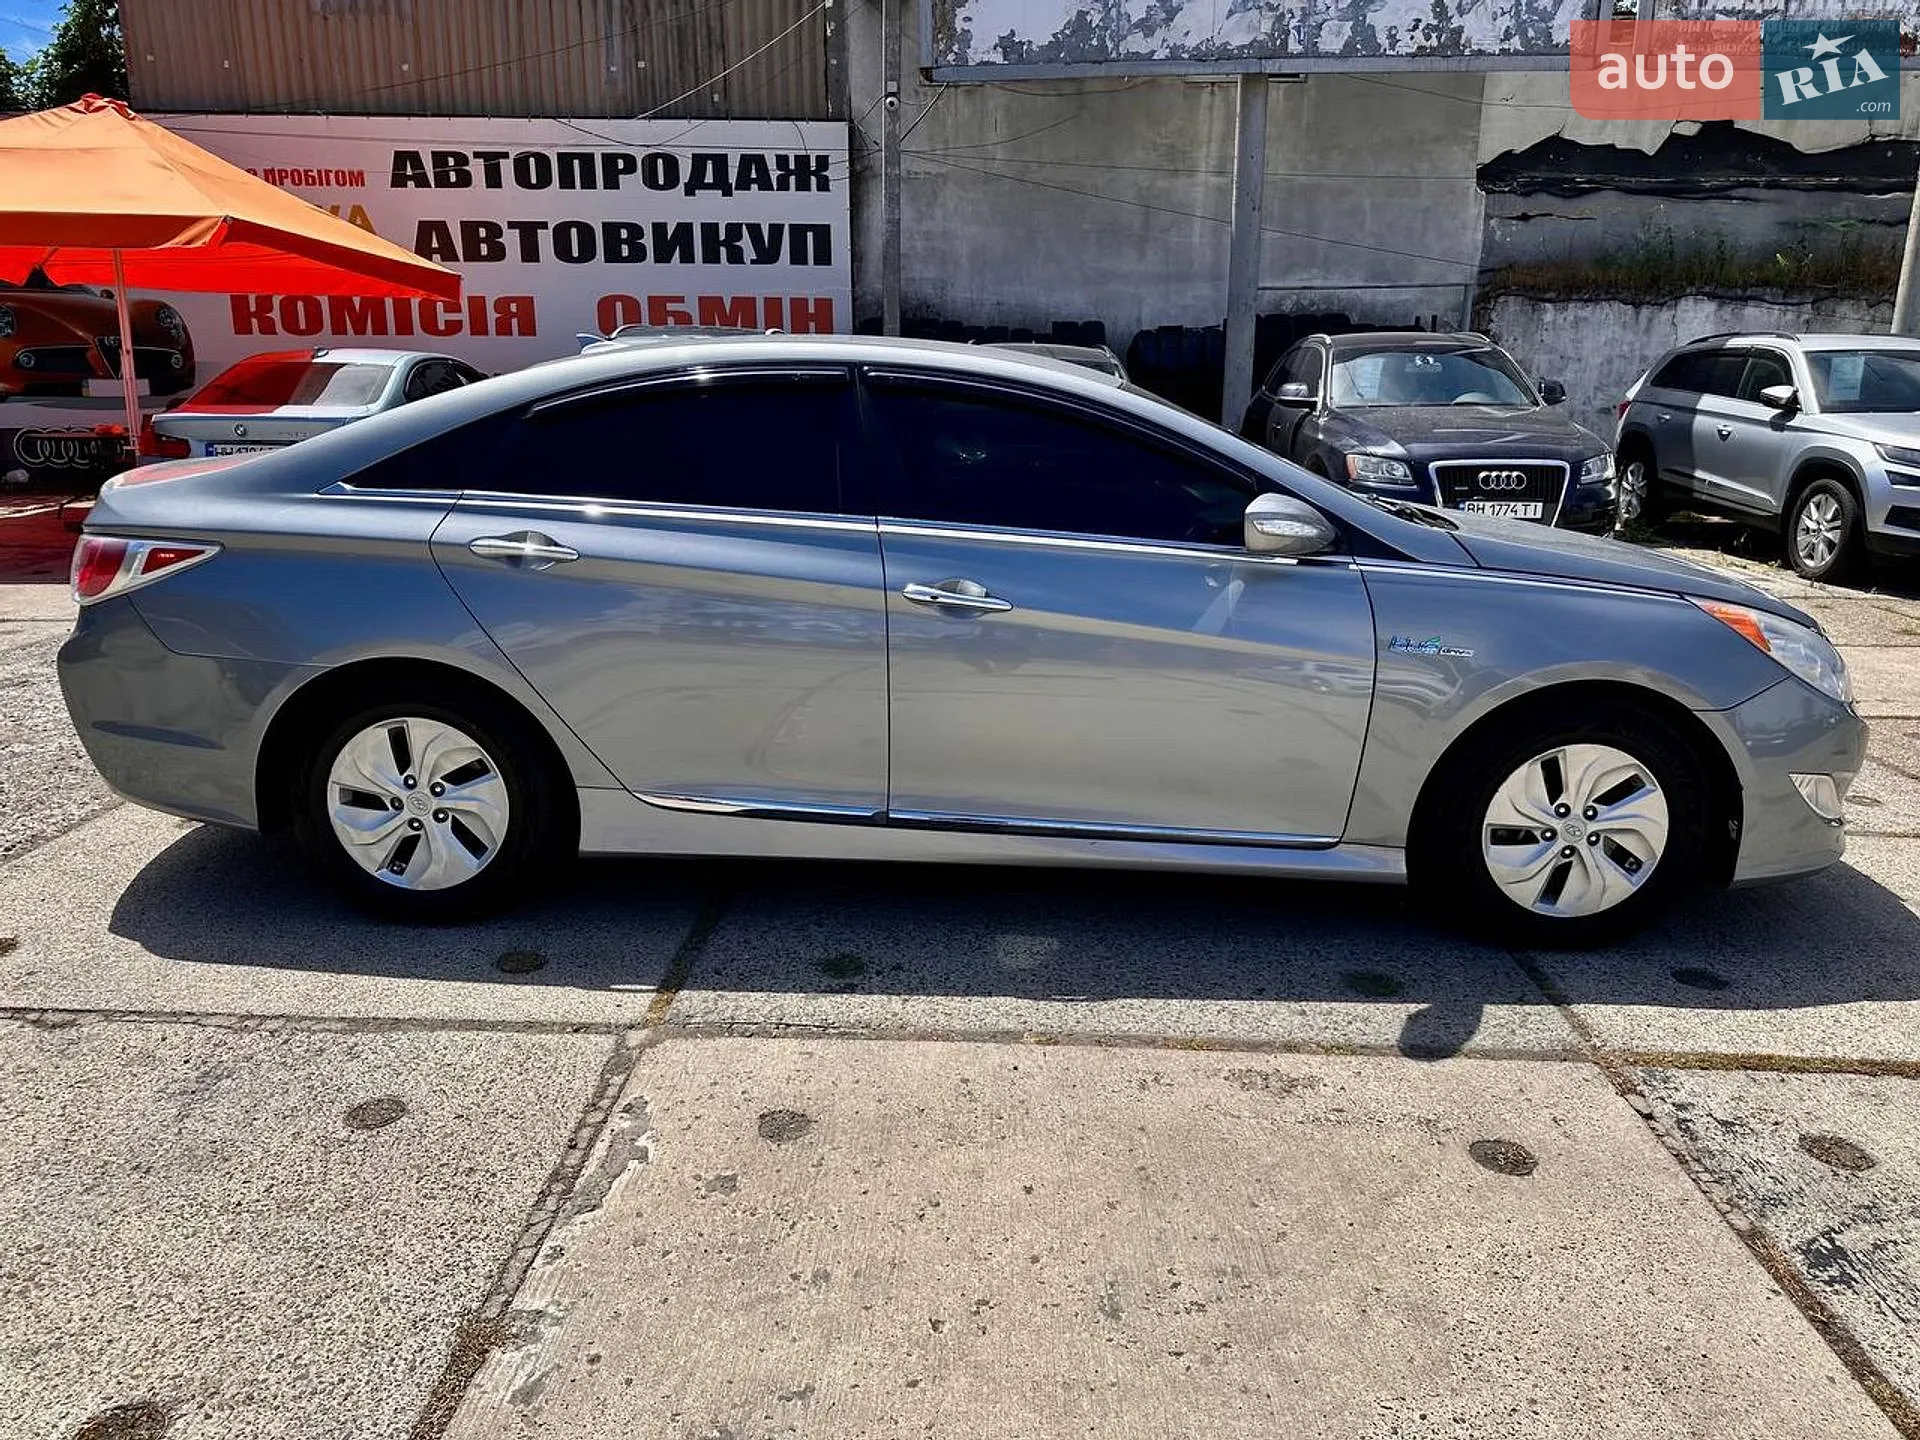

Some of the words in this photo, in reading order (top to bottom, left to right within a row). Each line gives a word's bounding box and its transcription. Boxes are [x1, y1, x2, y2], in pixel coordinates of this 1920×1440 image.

[263, 168, 366, 188] ПРОБІГОМ
[391, 149, 831, 198] АВТОПРОДАЖ
[414, 220, 832, 266] АВТОВИКУП
[230, 294, 537, 337] КОМІСІЯ
[597, 294, 834, 336] ОБМІН
[1489, 504, 1518, 517] 1774
